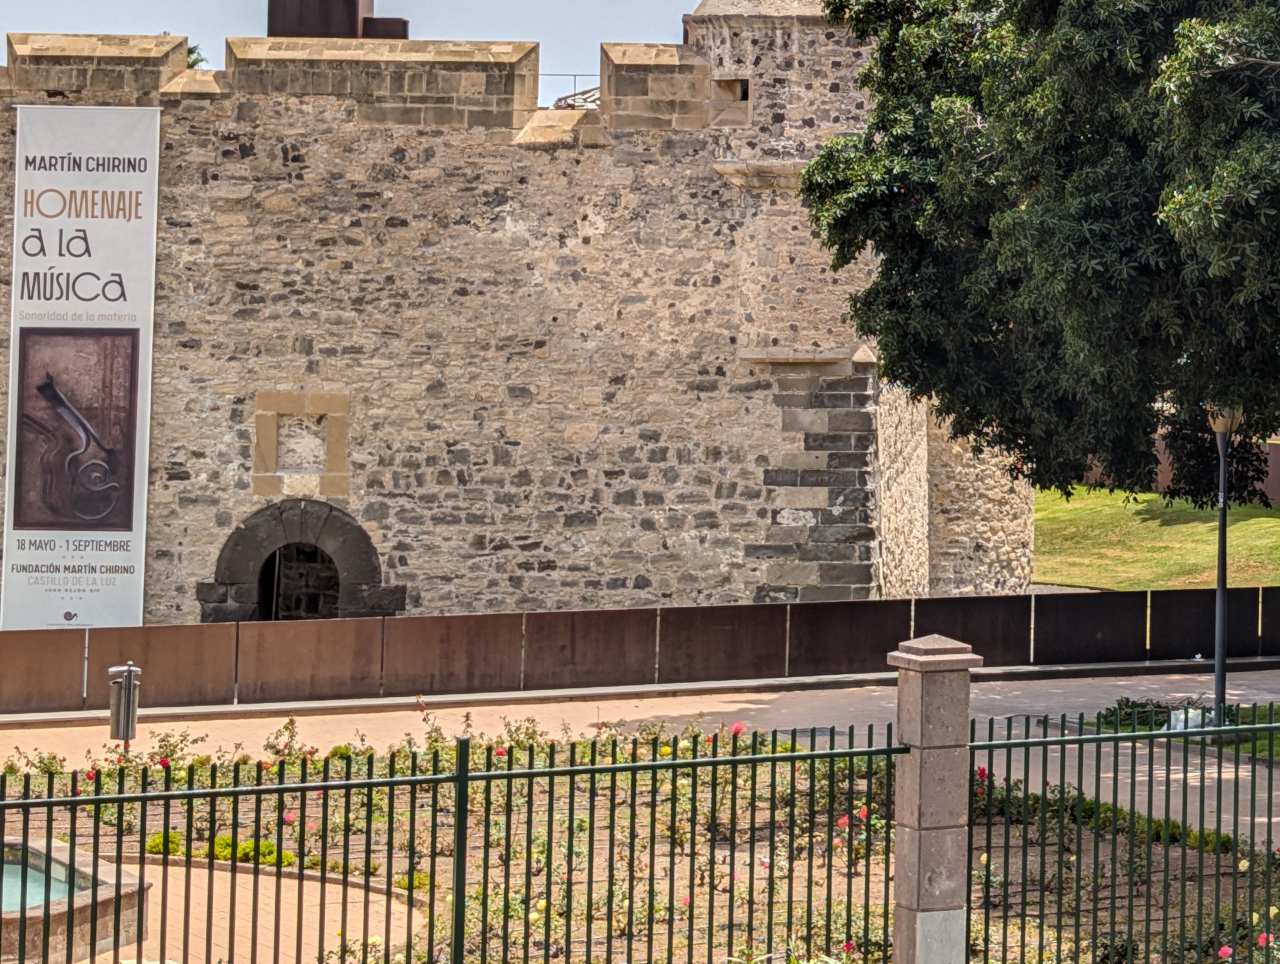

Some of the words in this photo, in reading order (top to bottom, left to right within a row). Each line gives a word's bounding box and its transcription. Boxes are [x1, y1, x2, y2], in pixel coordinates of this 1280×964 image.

[24, 152, 82, 172] MARTÍN
[86, 156, 148, 173] CHIRINO
[23, 188, 144, 223] HOMENAJE
[19, 310, 69, 321] Sonoridad
[70, 311, 84, 322] de
[86, 311, 95, 322] la
[98, 311, 137, 323] materia
[16, 538, 26, 551] 18
[29, 539, 56, 551] MAYO
[65, 539, 70, 551] 1
[72, 540, 132, 552] SEPTIEMBRE
[11, 562, 61, 574] FUNDACIÓN
[63, 563, 97, 574] MARTÍN
[100, 565, 135, 575] CHIRINO
[27, 576, 69, 586] CASTILLO
[72, 576, 83, 586] DE
[86, 576, 97, 586] LA
[100, 576, 117, 587] LUZ
